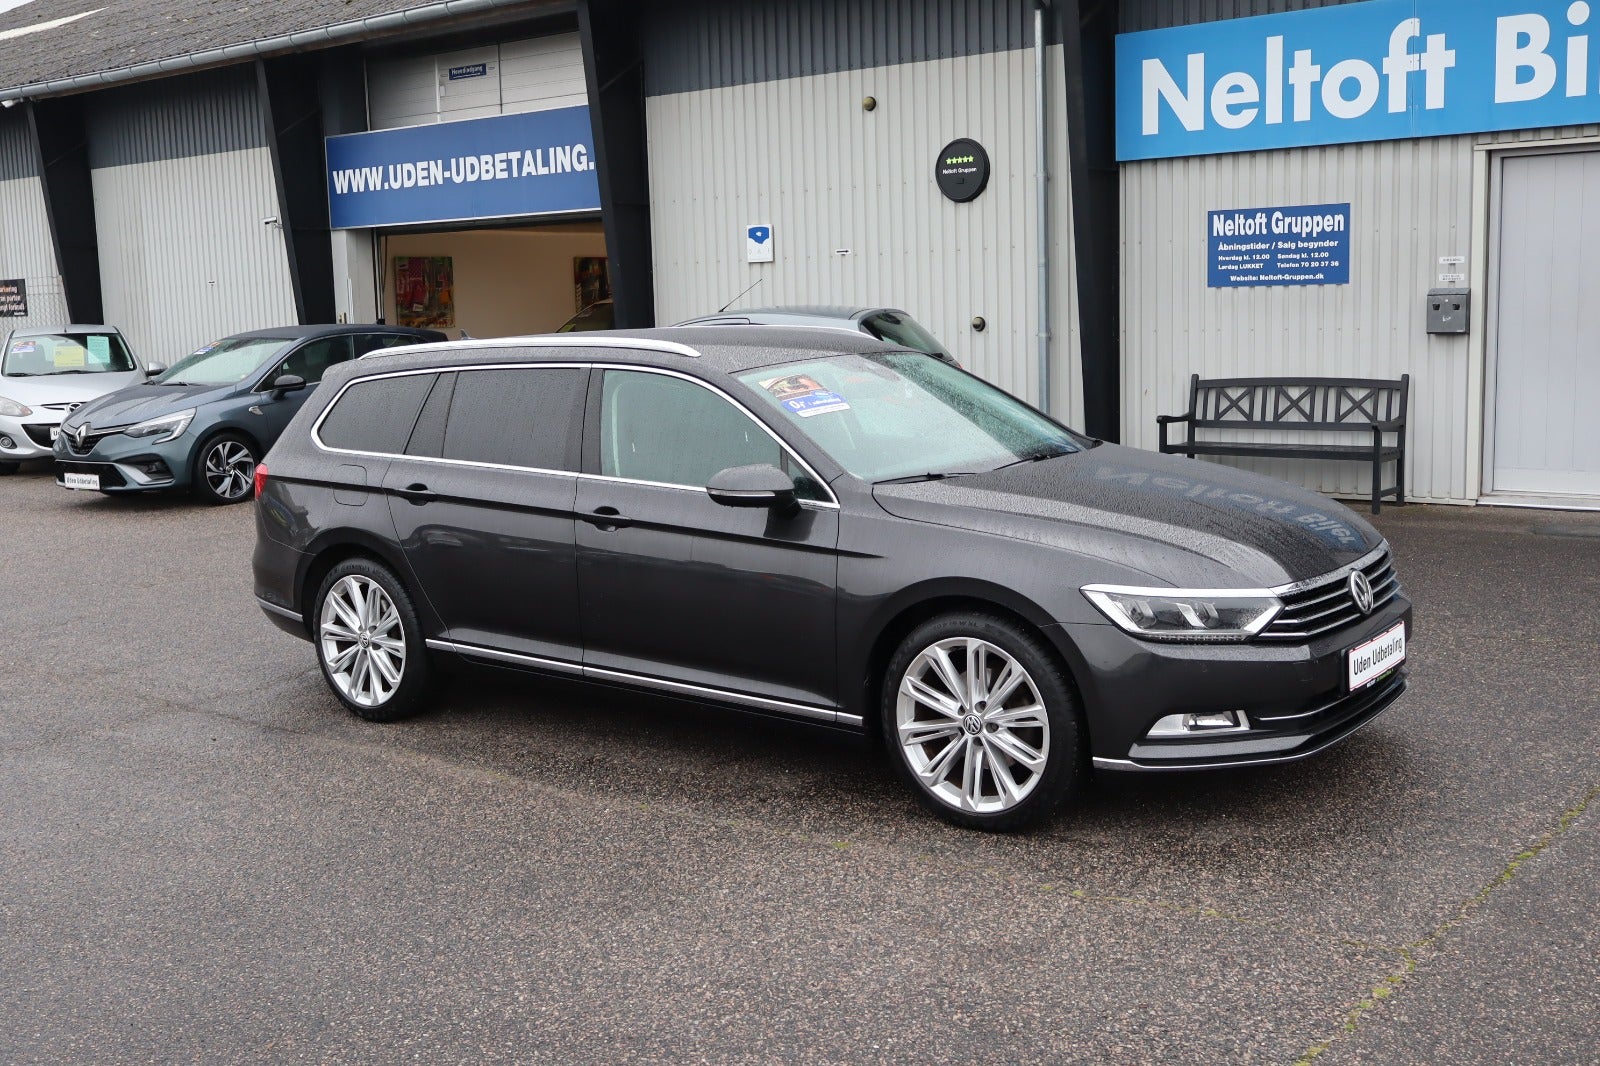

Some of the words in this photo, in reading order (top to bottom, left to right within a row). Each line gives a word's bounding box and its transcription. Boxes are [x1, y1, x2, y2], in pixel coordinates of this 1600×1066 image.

[1142, 17, 1456, 136] Neltoft
[1494, 0, 1600, 104] Bi
[332, 143, 595, 194] WWW.UDEN-UDBETALING.
[1213, 212, 1268, 236] Neltoft
[1271, 211, 1345, 237] Gruppen
[1218, 241, 1270, 251] Åbningstider
[1277, 241, 1296, 249] Salg
[1298, 240, 1339, 249] begynder
[1259, 273, 1324, 281] Neltoft-Gruppen.dk
[1353, 656, 1371, 676] Uden
[1372, 637, 1402, 666] Udbetaling
